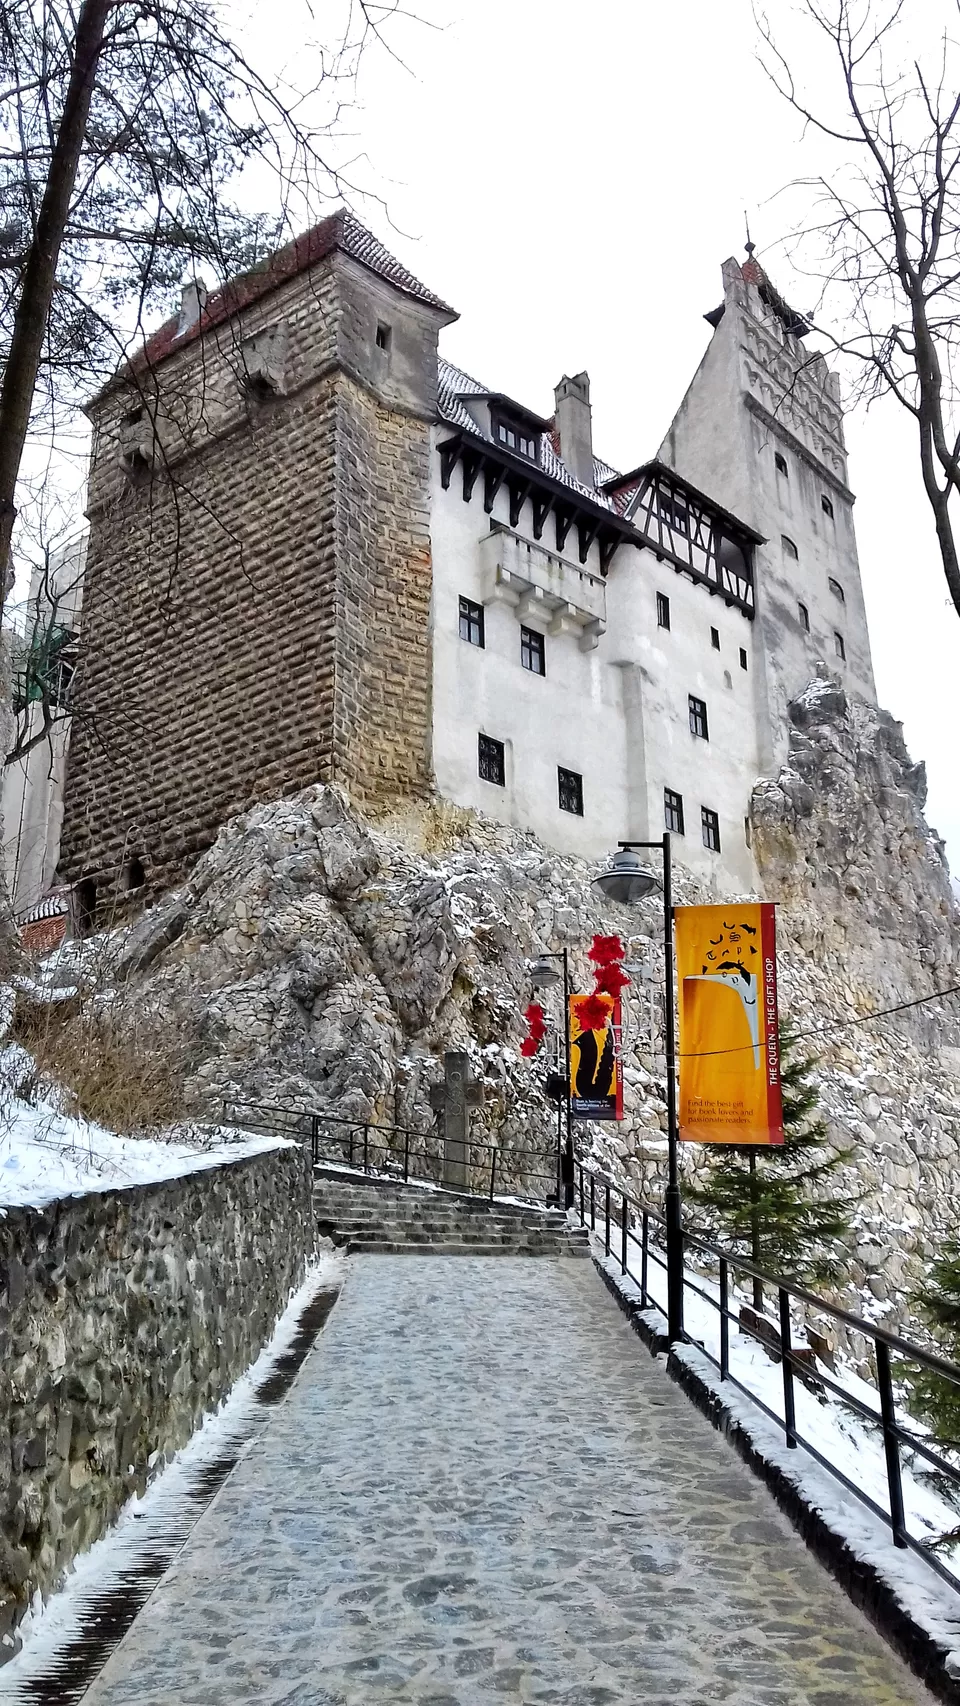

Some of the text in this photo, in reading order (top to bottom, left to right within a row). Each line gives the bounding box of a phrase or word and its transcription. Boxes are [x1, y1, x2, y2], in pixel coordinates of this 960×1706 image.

[765, 957, 774, 983] SHOP
[766, 985, 774, 1005] GIFT
[767, 1007, 775, 1025] THE
[733, 1101, 744, 1109] gift
[718, 1108, 738, 1116] lovers
[688, 1116, 724, 1124] passionate
